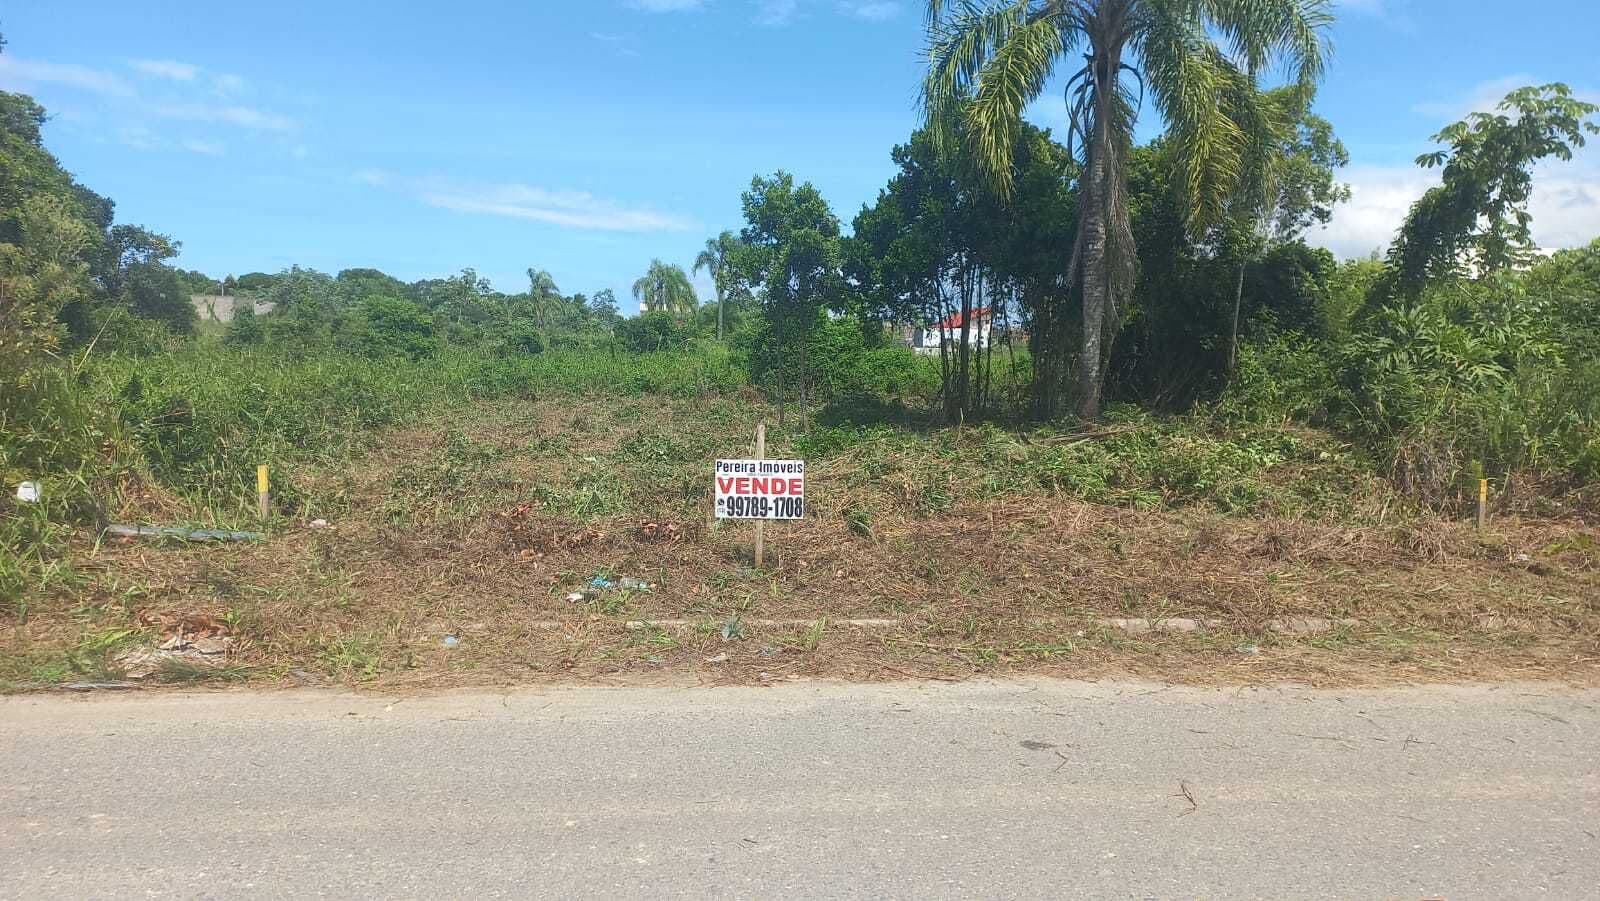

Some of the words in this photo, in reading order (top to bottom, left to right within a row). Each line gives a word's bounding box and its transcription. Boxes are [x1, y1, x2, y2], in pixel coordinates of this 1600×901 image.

[716, 461, 756, 473] Pereira
[759, 461, 803, 473] Imóveis
[717, 477, 803, 495] VENDE
[726, 496, 803, 518] 99789-1708
